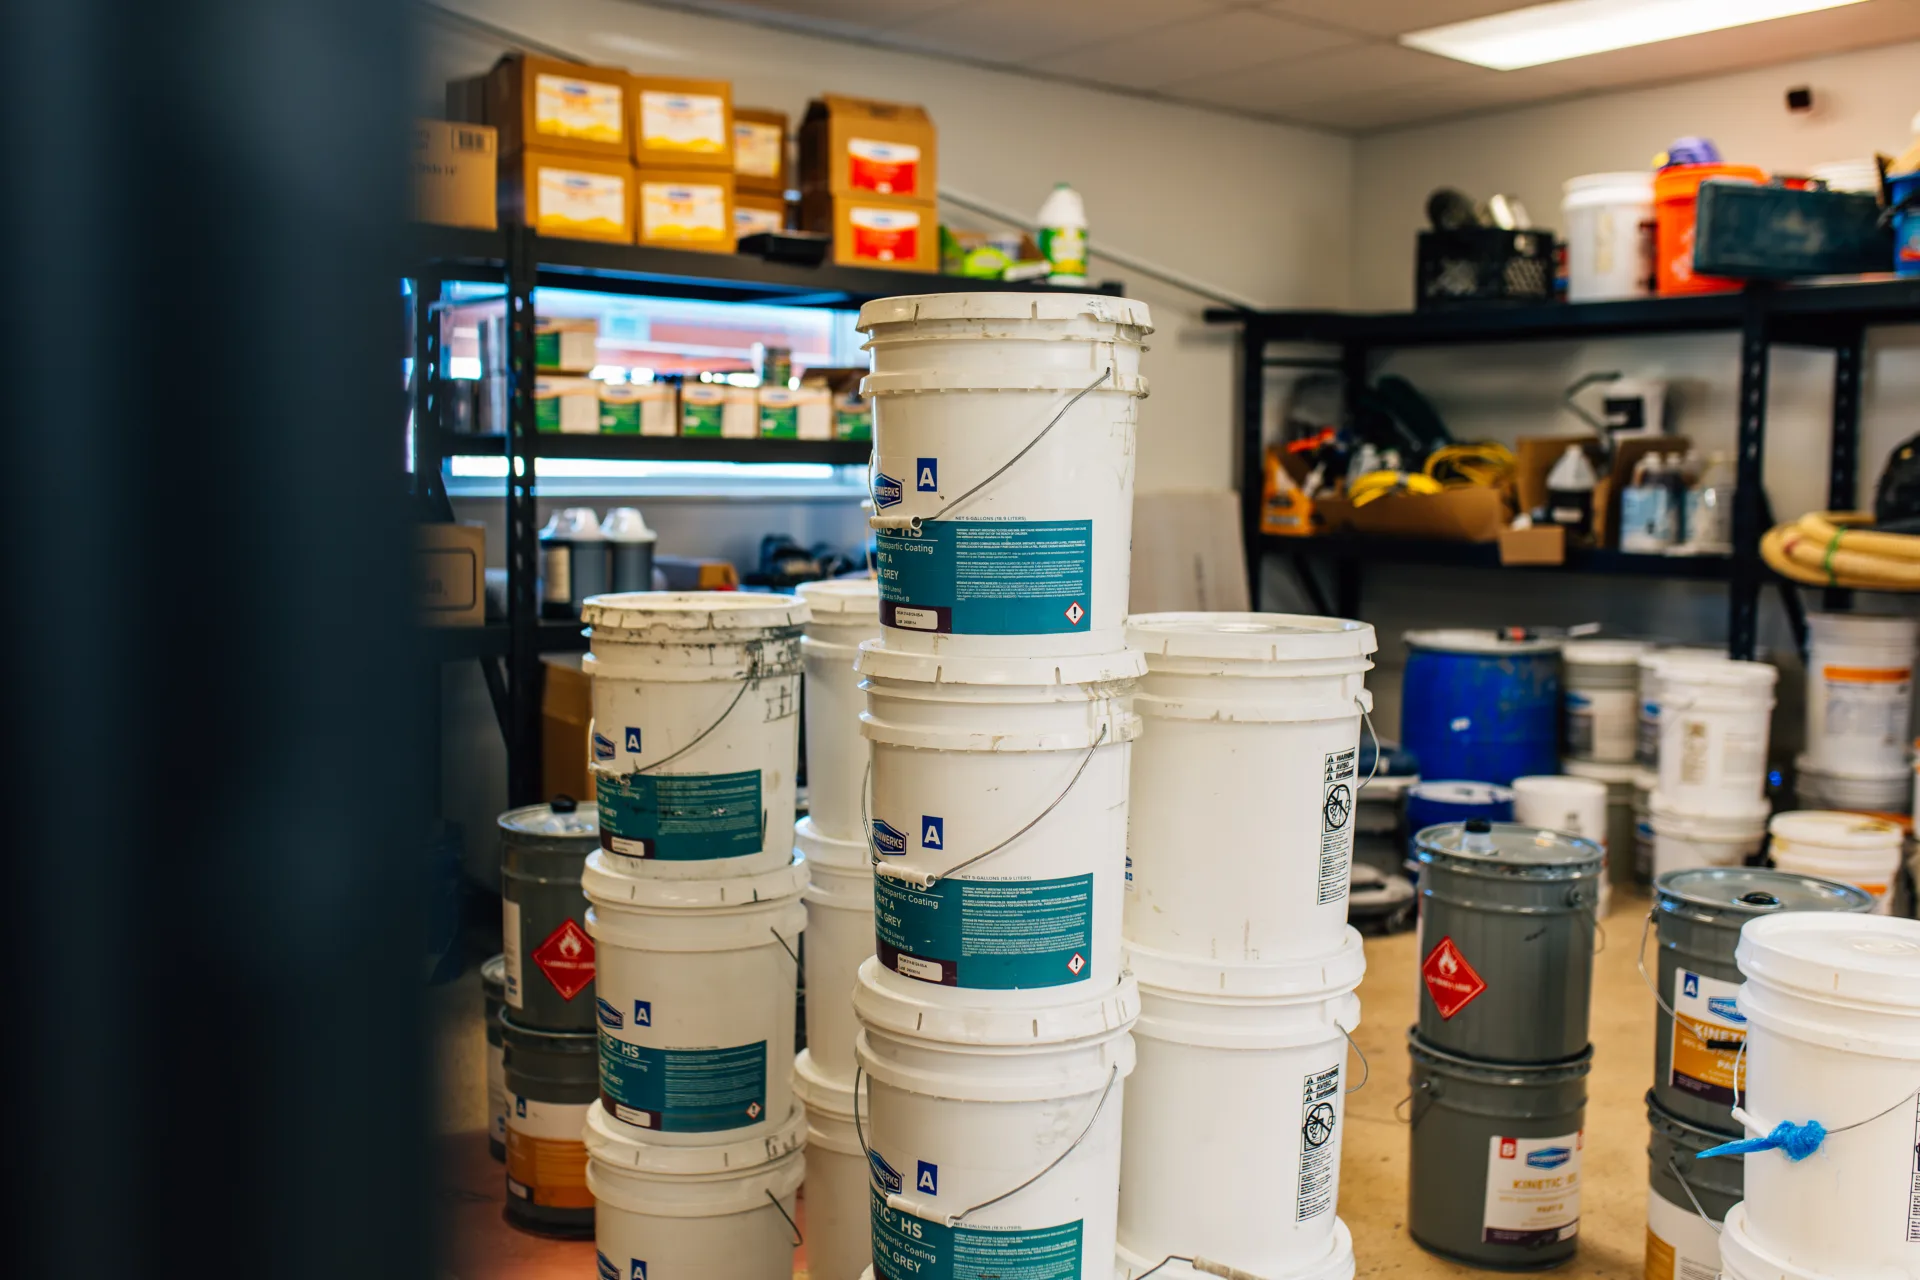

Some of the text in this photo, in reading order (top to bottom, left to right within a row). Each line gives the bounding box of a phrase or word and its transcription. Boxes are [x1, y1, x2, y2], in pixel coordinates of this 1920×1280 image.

[919, 467, 936, 487] A
[904, 543, 934, 555] Coating
[887, 554, 893, 564] A
[883, 568, 899, 580] GREY
[627, 734, 640, 750] A
[924, 825, 941, 845] A
[889, 901, 895, 911] A
[908, 894, 939, 910] Coating
[884, 912, 902, 928] GREY
[1685, 980, 1697, 996] A
[636, 1008, 649, 1023] A
[621, 1043, 640, 1058] HS
[918, 1170, 936, 1191] A
[901, 1216, 923, 1239] HS
[904, 1243, 936, 1264] Coating
[892, 1251, 922, 1273] GREY
[632, 1266, 645, 1280] A
